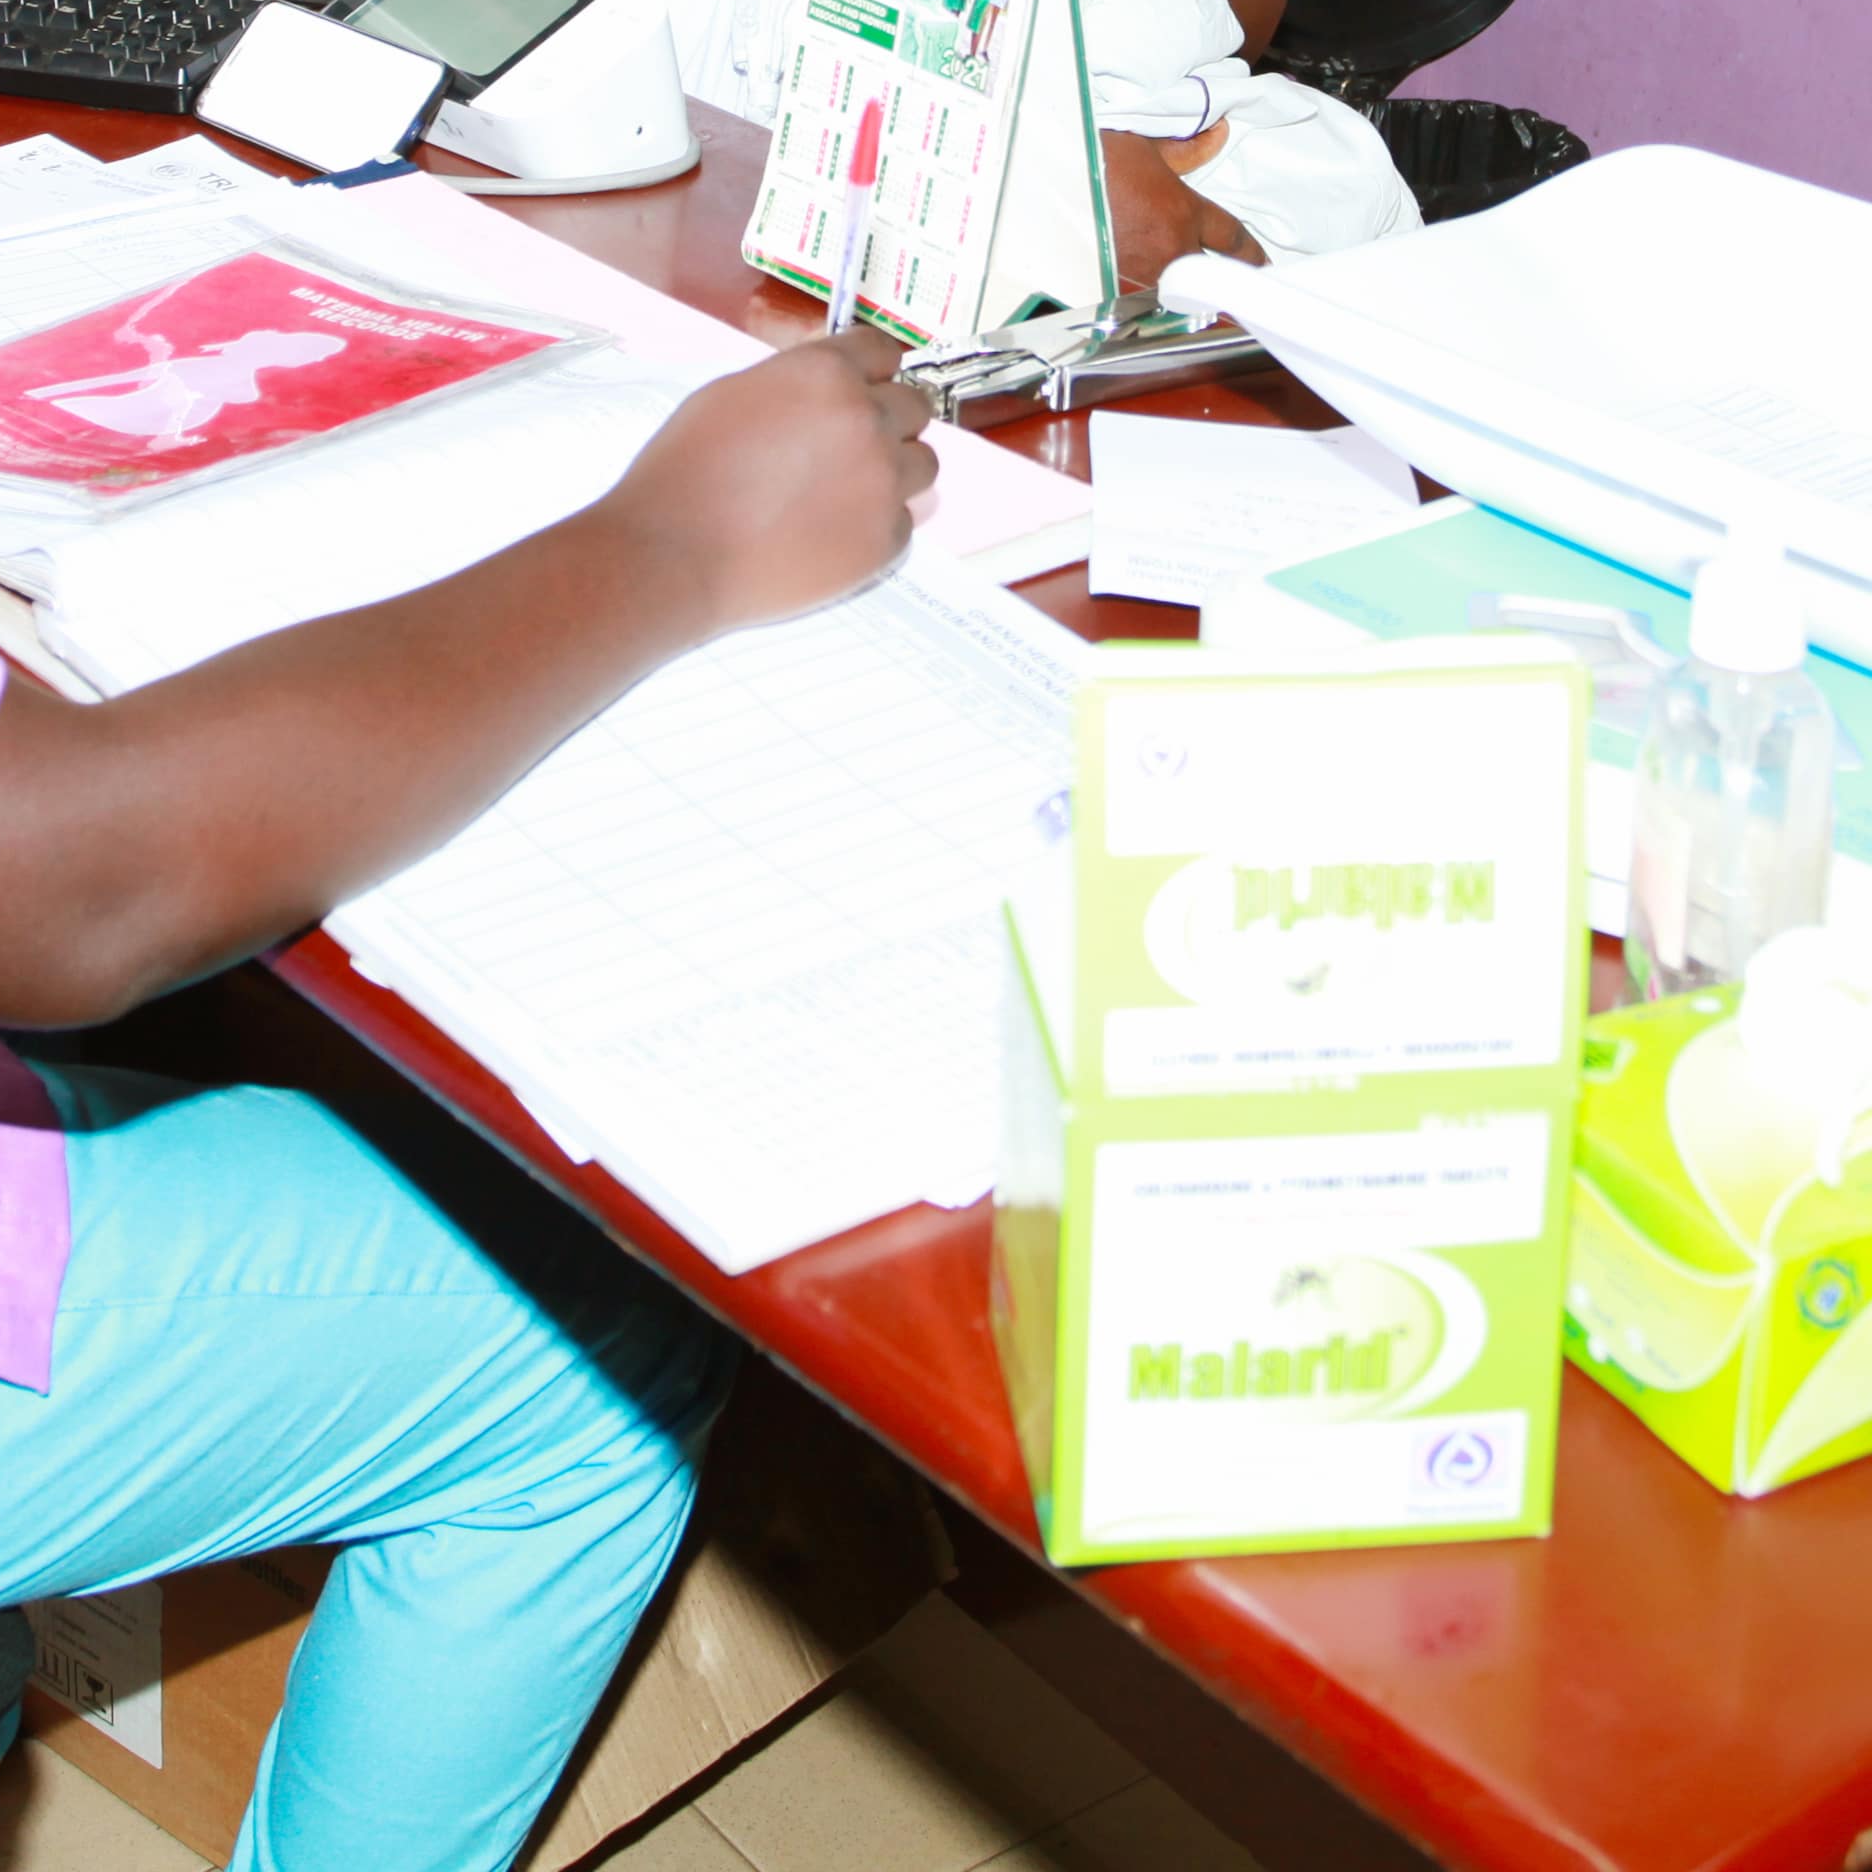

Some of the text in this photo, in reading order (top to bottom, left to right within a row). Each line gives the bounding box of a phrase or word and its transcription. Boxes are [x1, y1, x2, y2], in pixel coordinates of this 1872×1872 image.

[940, 48, 989, 90] 2021
[289, 286, 486, 343] MATERNAL HEALTH
[308, 308, 427, 342] RECORDS
[1125, 1326, 1394, 1403] Malarid
